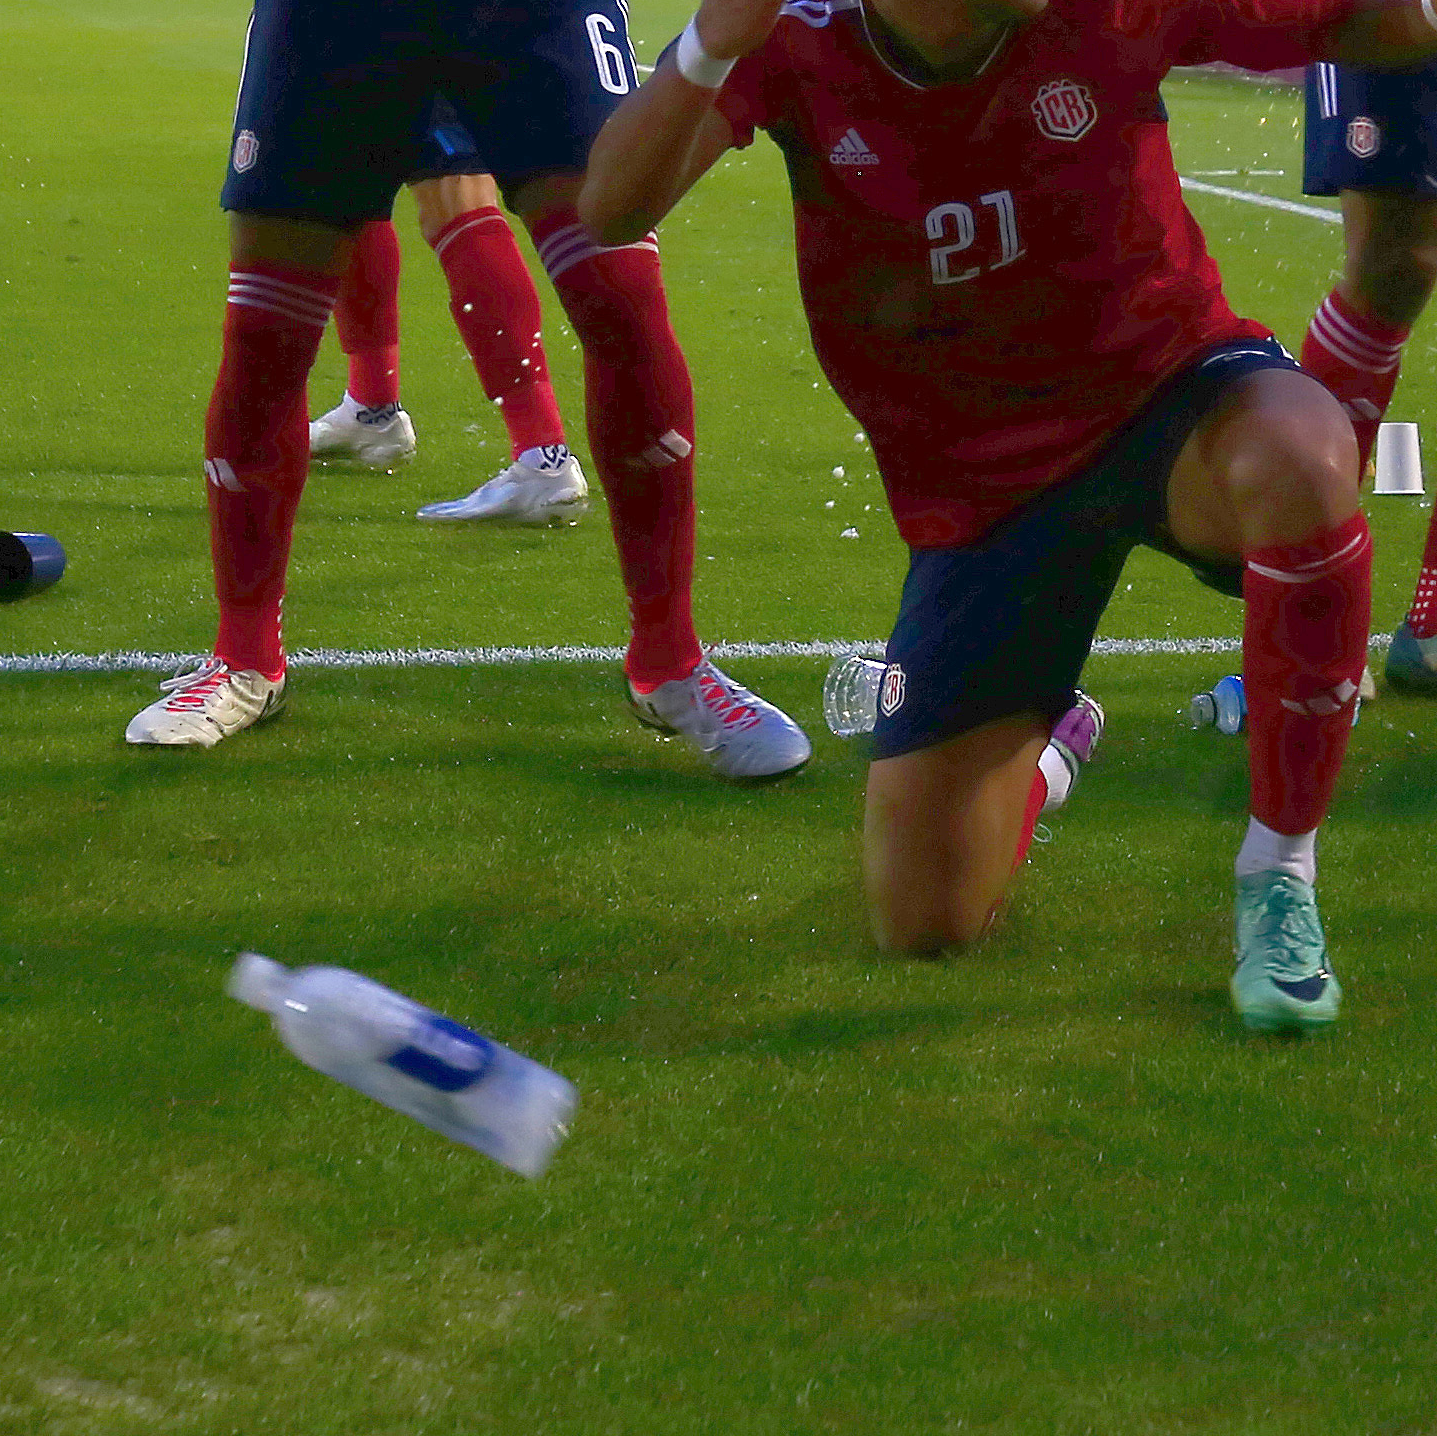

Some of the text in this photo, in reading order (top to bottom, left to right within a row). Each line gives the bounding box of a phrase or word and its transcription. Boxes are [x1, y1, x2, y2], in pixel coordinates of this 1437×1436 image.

[585, 13, 630, 95] 6
[829, 151, 880, 165] adidas
[925, 189, 1027, 285] 21
